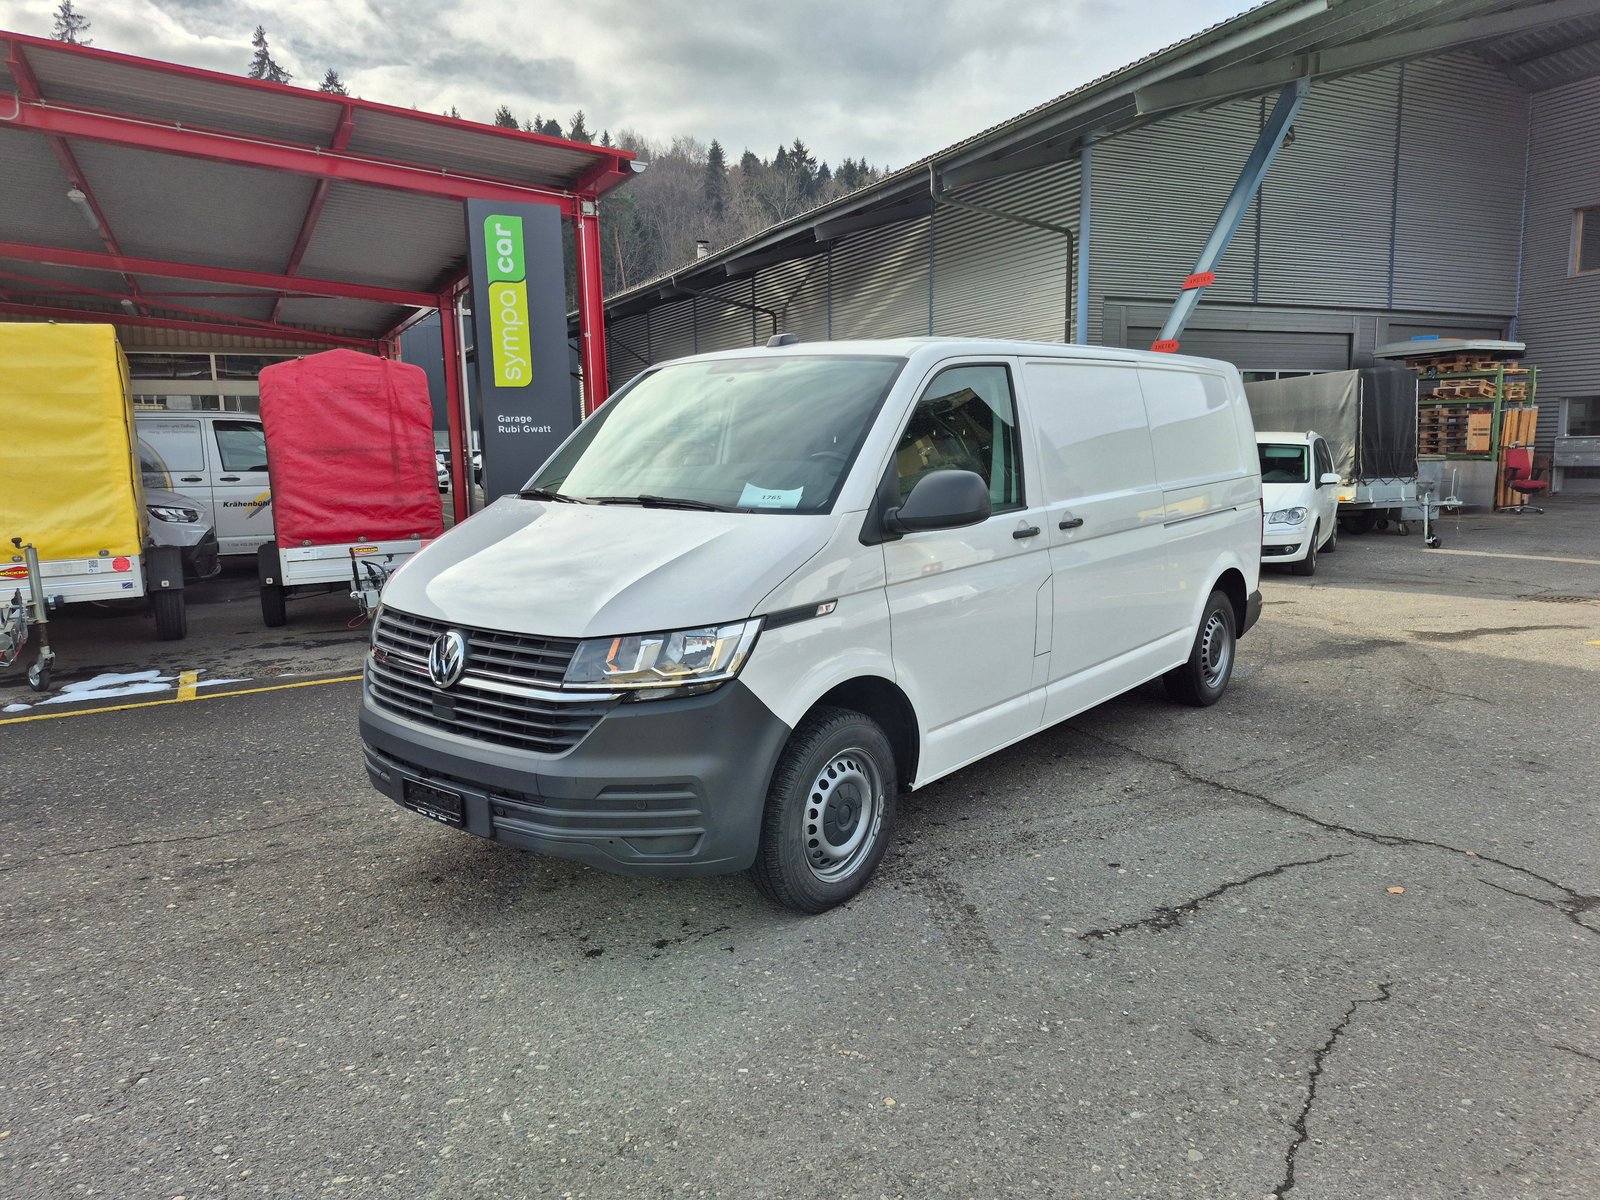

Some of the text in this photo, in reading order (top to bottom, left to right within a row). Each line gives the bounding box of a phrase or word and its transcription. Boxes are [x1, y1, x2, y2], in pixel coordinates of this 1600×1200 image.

[495, 223, 526, 381] sympa car
[497, 414, 533, 424] Garage
[498, 425, 552, 433] Rubi Gwatt
[223, 500, 271, 508] Krähenbühl
